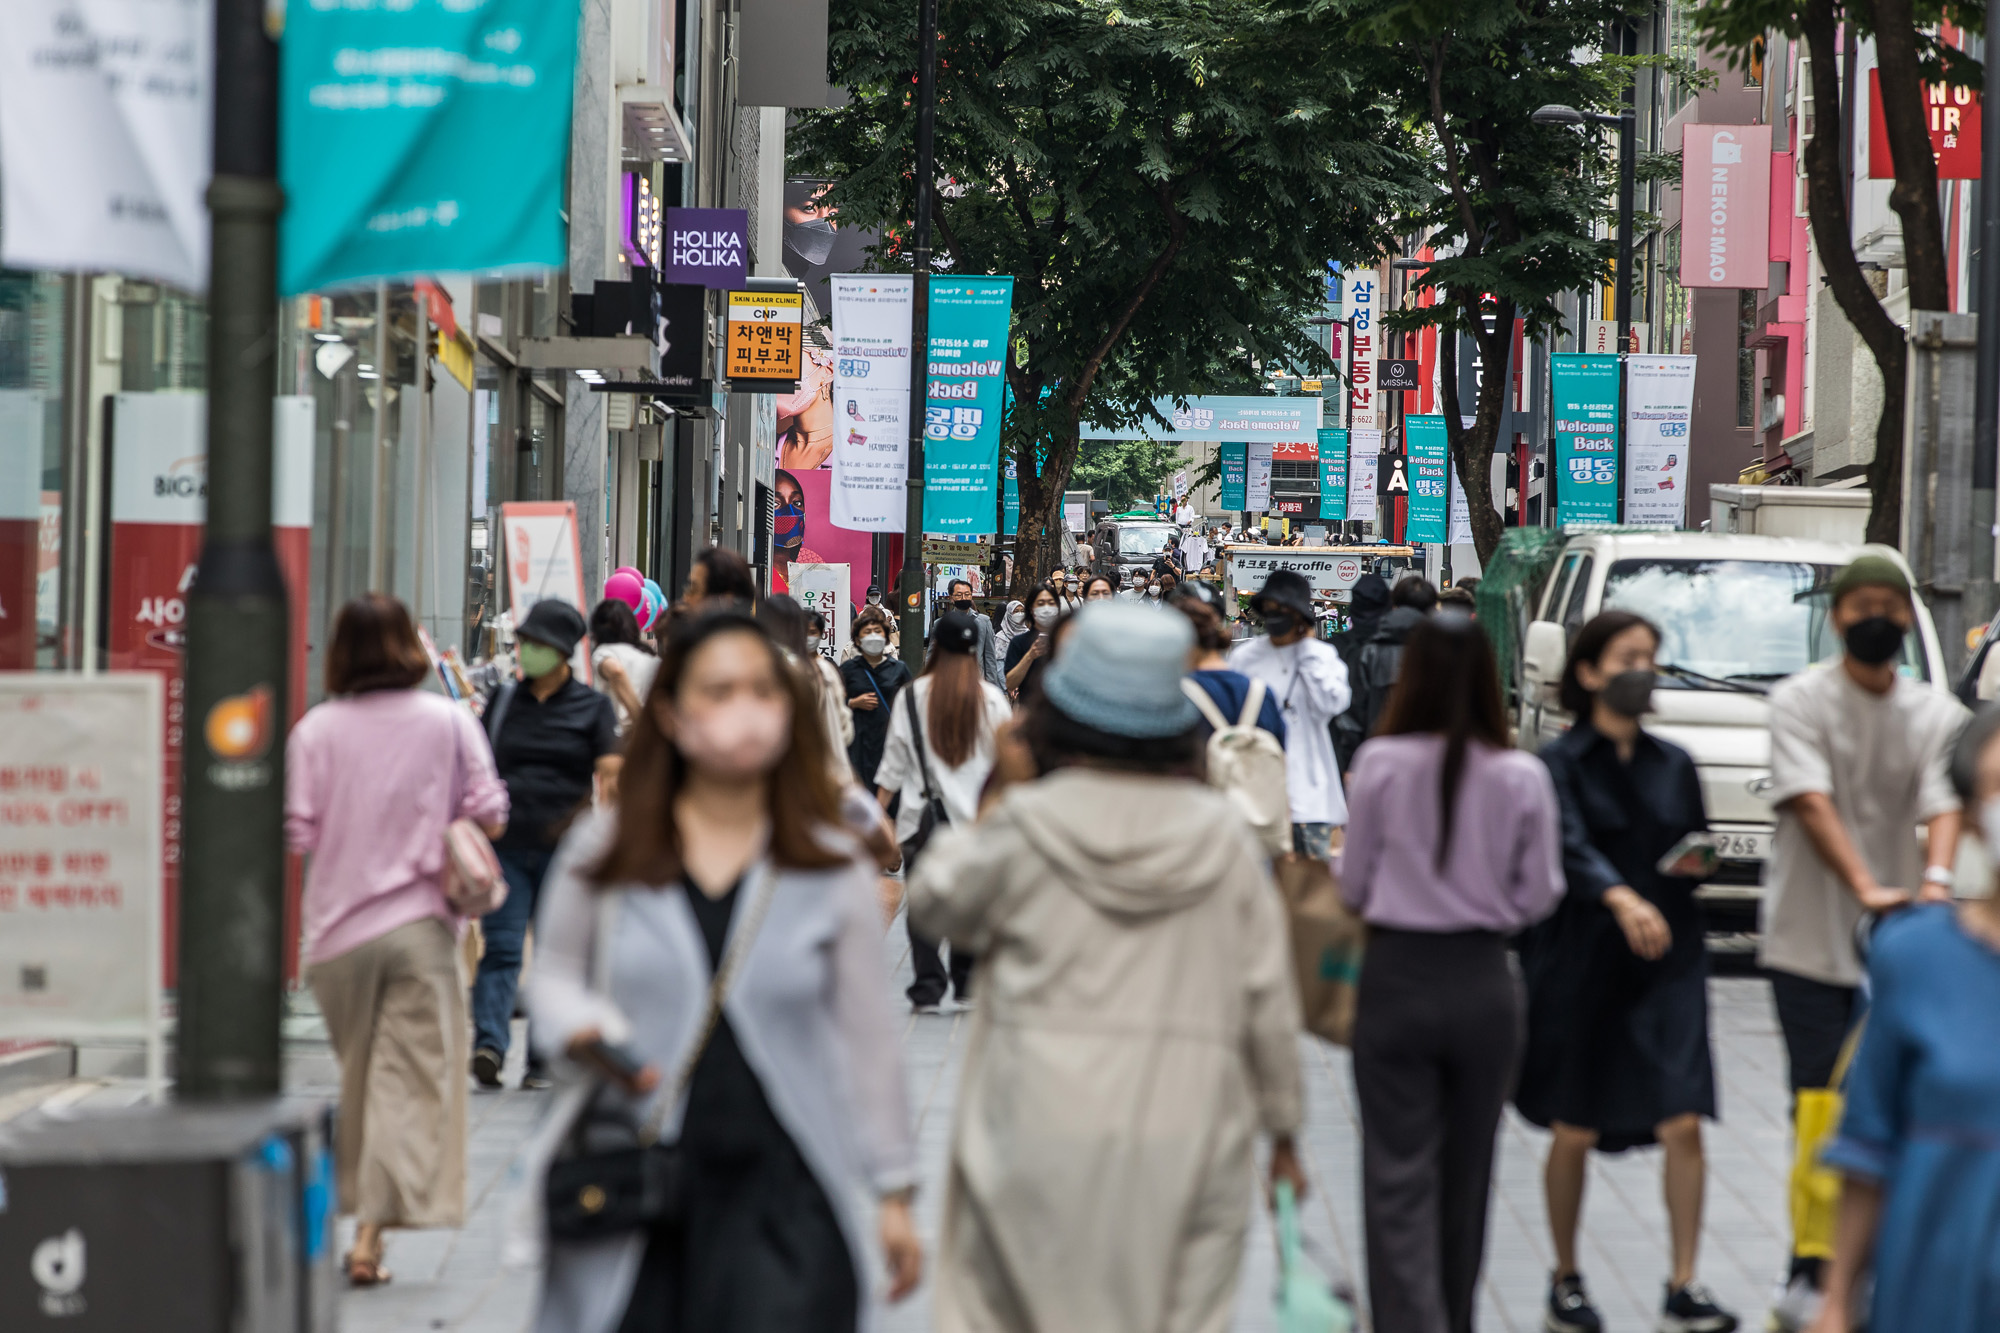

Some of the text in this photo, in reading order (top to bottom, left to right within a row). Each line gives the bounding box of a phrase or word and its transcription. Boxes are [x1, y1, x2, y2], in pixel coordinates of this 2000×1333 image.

[673, 230, 742, 249] HOLIKA
[673, 248, 742, 267] HOLIKA
[775, 297, 797, 305] CLINIC
[753, 309, 778, 320] CNP
[737, 325, 793, 345] 차앤박
[1597, 326, 1606, 354] CHIC
[736, 347, 791, 365] 피부과
[1380, 379, 1414, 387] MISSHA
[1631, 411, 1688, 420] Welcome Back
[1556, 419, 1615, 434] Welcome
[1573, 436, 1615, 451] Back
[1320, 457, 1346, 465] Welcome
[1408, 456, 1444, 466] Welcome
[1328, 465, 1346, 473] Back
[1419, 466, 1444, 477] Back
[1568, 456, 1616, 485] 명동
[1326, 474, 1346, 488] 명동
[1415, 479, 1446, 498] 명동
[1280, 503, 1302, 512] 상품권
[1237, 559, 1333, 572] #크로플 #croffle
